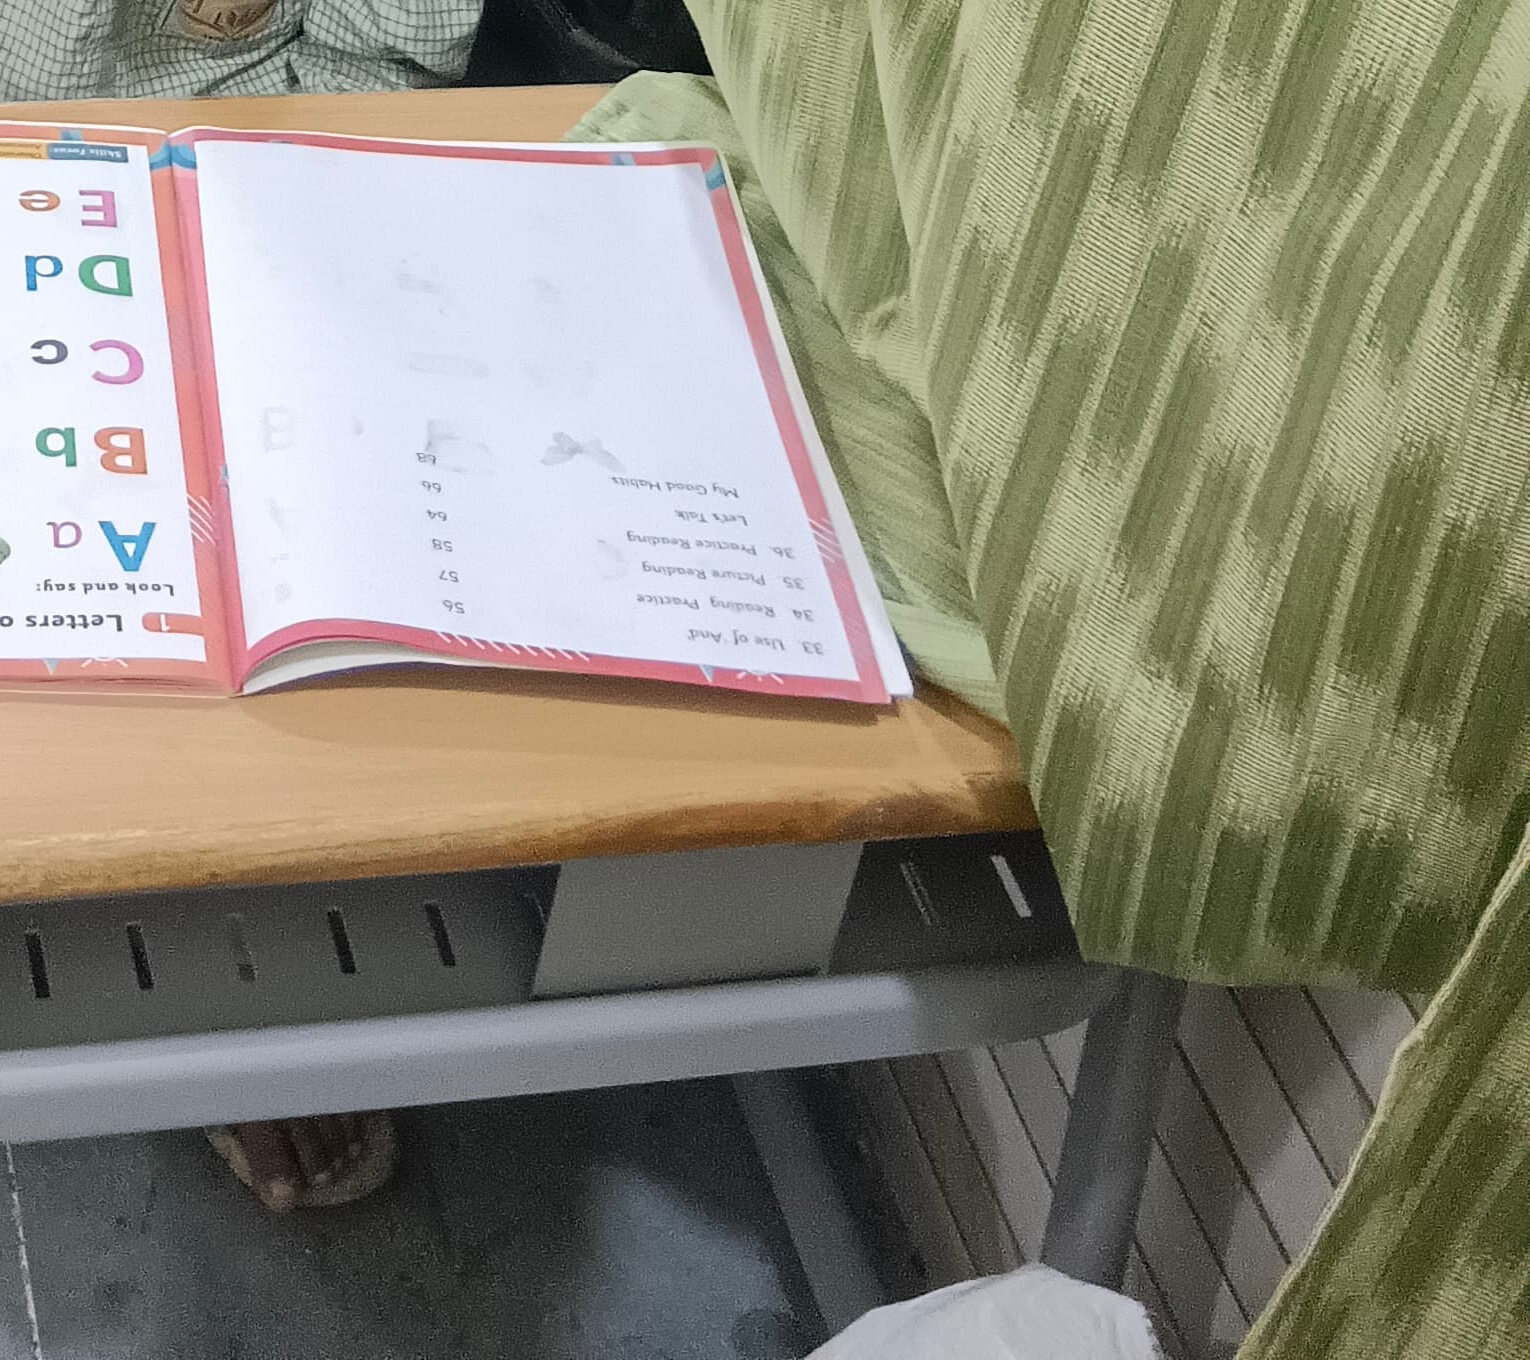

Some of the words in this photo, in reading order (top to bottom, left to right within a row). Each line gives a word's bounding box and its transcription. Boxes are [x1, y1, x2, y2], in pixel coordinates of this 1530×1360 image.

[19, 190, 60, 211] e
[79, 190, 118, 228] E
[25, 255, 63, 291] d
[78, 255, 133, 297] D
[31, 340, 68, 364] c
[90, 340, 144, 385] C
[36, 427, 77, 467] b
[94, 427, 148, 475] B
[422, 481, 441, 493] 66
[612, 477, 661, 491] Habits
[665, 482, 707, 495] Good
[712, 483, 739, 498] My
[675, 510, 707, 523] Talk
[46, 522, 82, 548] a
[626, 531, 691, 549] Reading
[98, 521, 156, 572] A
[432, 539, 453, 552] 58
[696, 540, 757, 556] Practice
[439, 570, 459, 583] 57
[642, 561, 706, 580] Reading
[712, 570, 766, 586] Picture
[37, 579, 75, 591] say:
[83, 583, 118, 594] and
[125, 583, 174, 596] Look
[443, 600, 465, 614] 56
[637, 594, 699, 610] Practice
[710, 596, 775, 618] Reading
[26, 615, 122, 632] Letters
[159, 615, 169, 631] 1
[733, 630, 748, 645] of
[755, 636, 785, 651] Use
